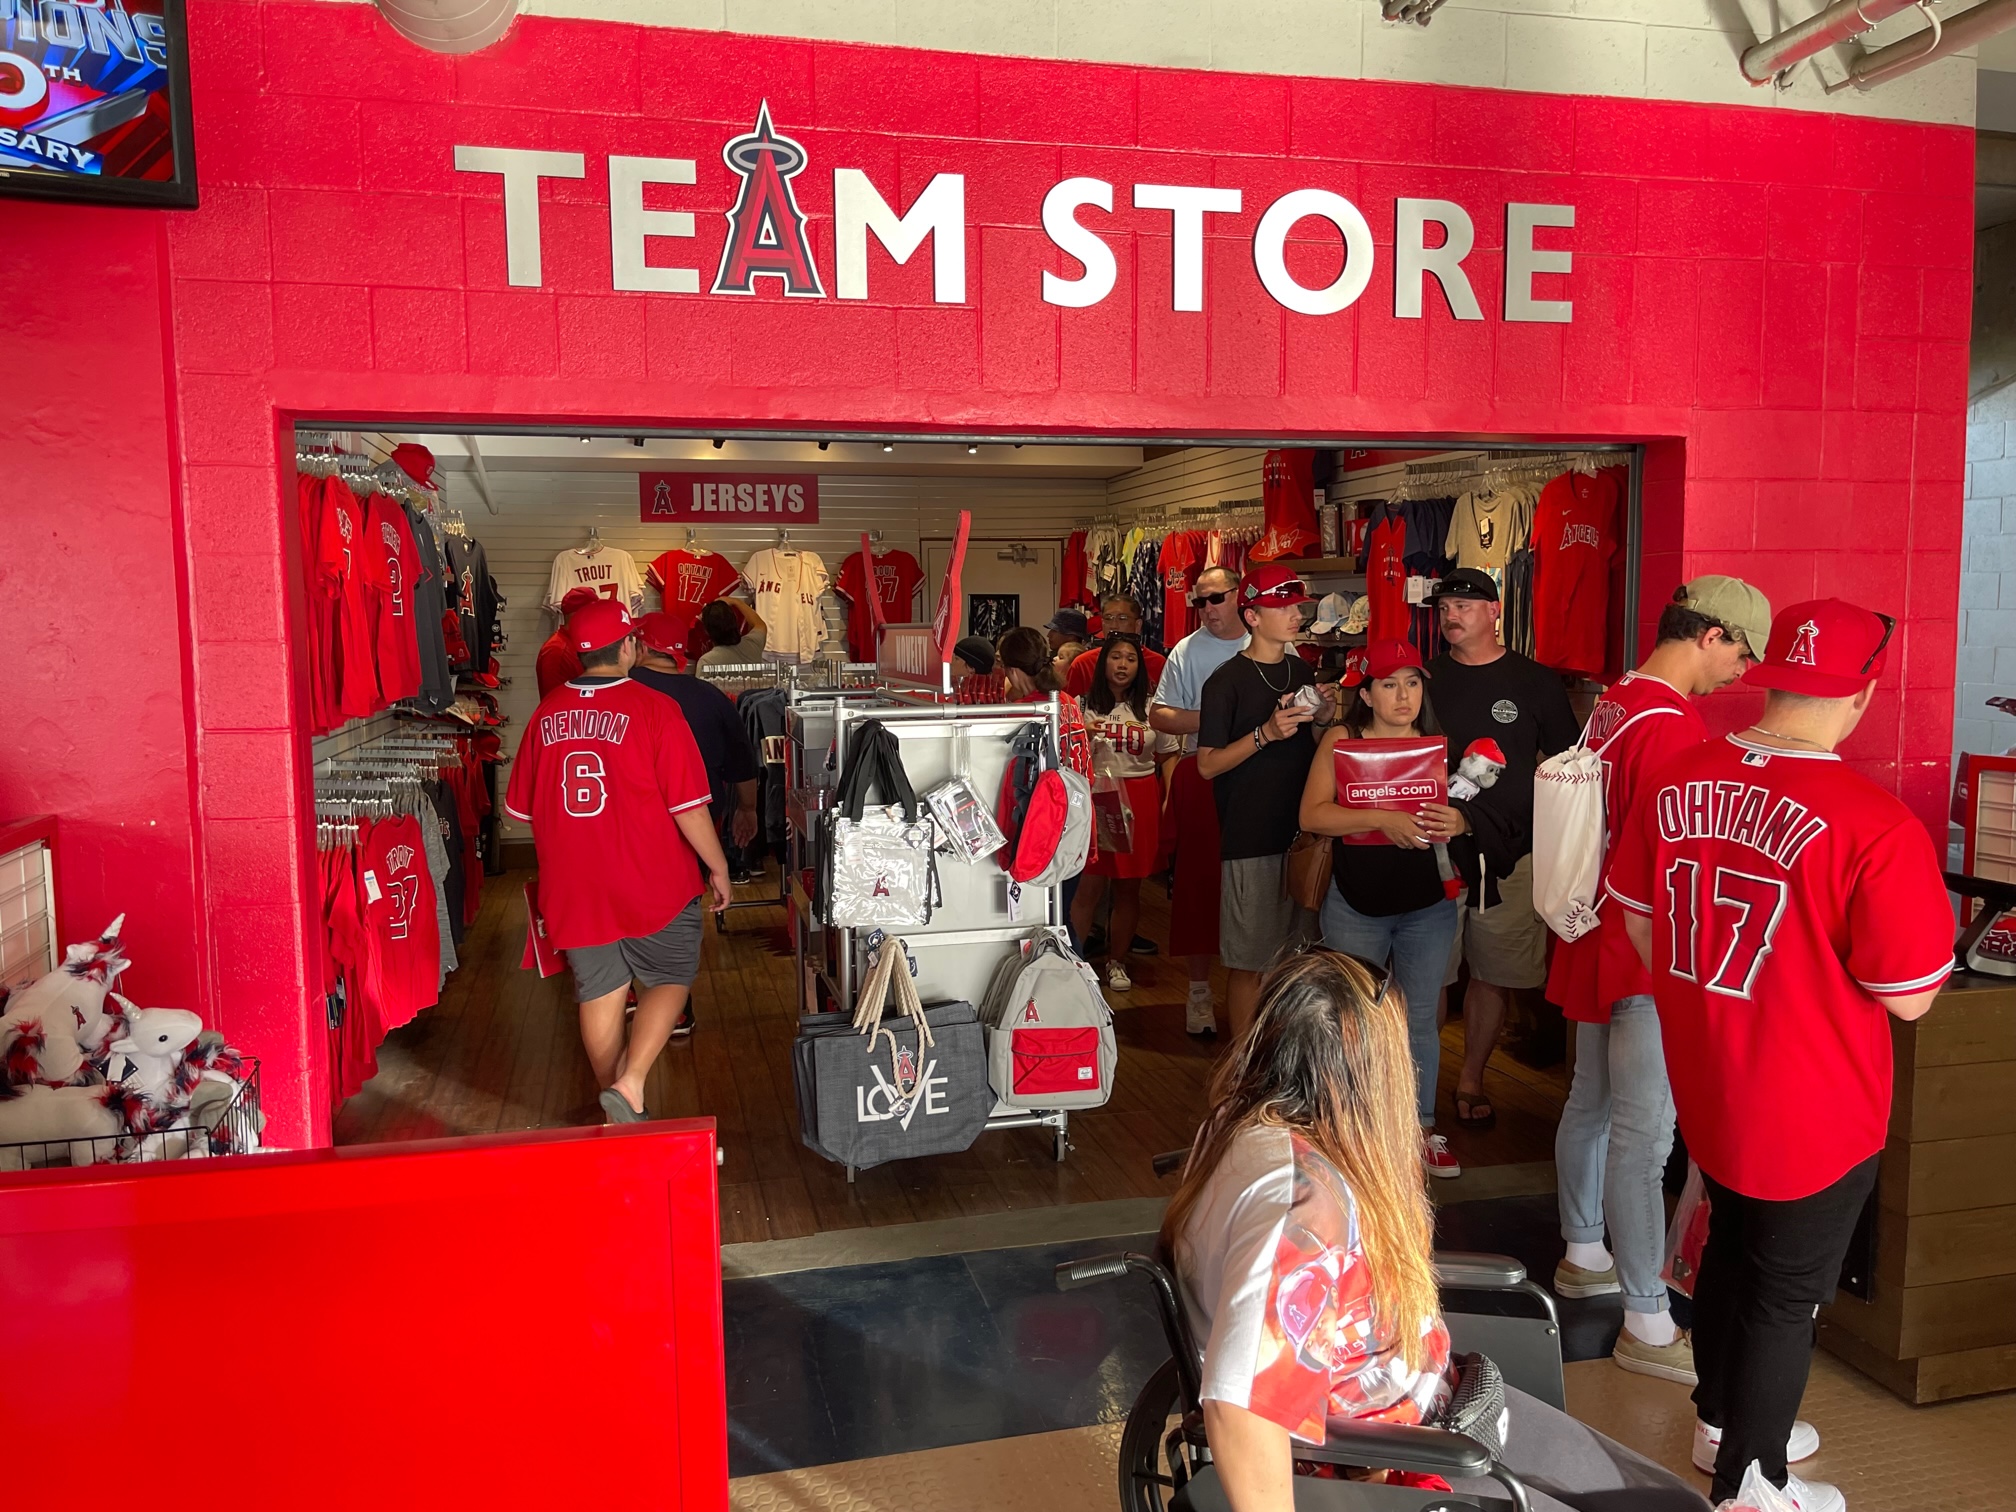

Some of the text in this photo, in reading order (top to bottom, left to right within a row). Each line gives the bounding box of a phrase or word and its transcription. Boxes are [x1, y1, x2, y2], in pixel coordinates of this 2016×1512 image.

[0, 0, 167, 69] IONS
[0, 128, 95, 170] SARY
[453, 97, 1576, 323] TEAM STORE
[690, 483, 805, 513] JERSEYS
[574, 564, 613, 583] TROUT
[677, 562, 713, 579] OHTANI
[678, 574, 709, 603] 17
[873, 565, 897, 577] ROUT
[895, 634, 928, 676] NOVELTY
[541, 709, 630, 746] RENDON
[1109, 714, 1121, 722] THE
[561, 750, 608, 818] 6
[1351, 785, 1433, 800] angels.com
[1657, 780, 1829, 872] OHTANI
[1665, 857, 1789, 1002] 17
[856, 1058, 950, 1132] LOVE
